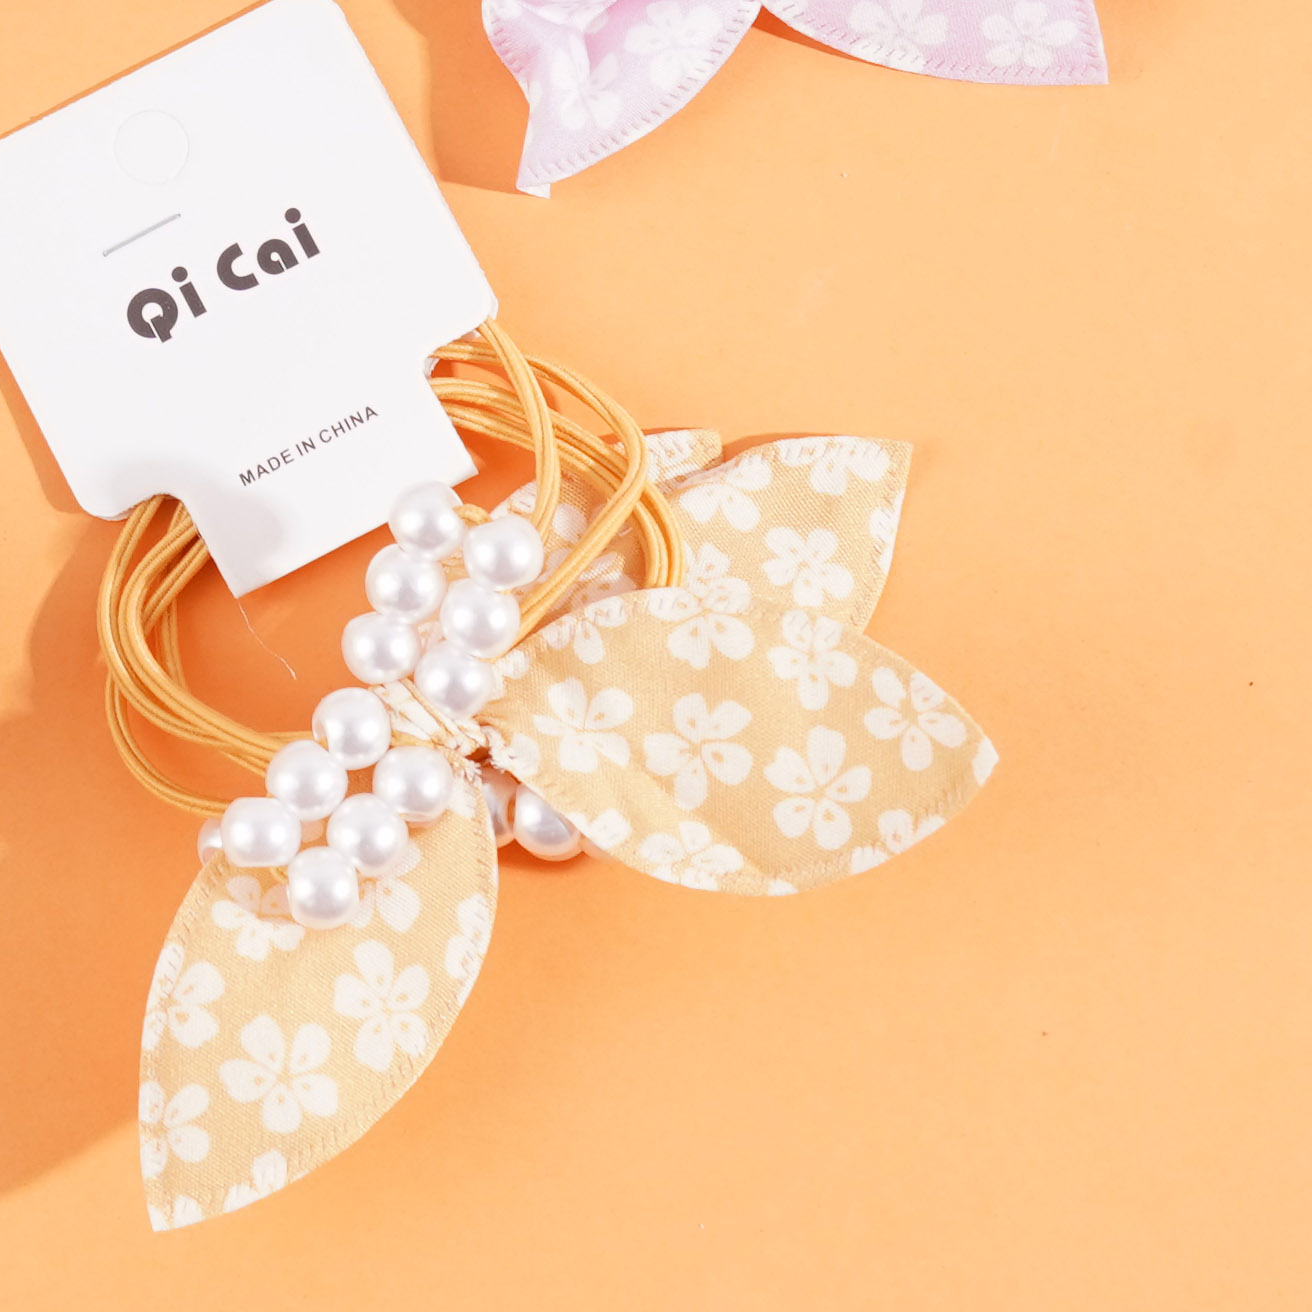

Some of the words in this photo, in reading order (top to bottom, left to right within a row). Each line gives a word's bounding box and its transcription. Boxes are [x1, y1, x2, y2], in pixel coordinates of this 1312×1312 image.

[126, 266, 208, 343] Qi
[216, 207, 321, 291] Cai
[239, 449, 294, 487] MADE
[295, 437, 317, 456] IN
[319, 406, 378, 444] CHINA
